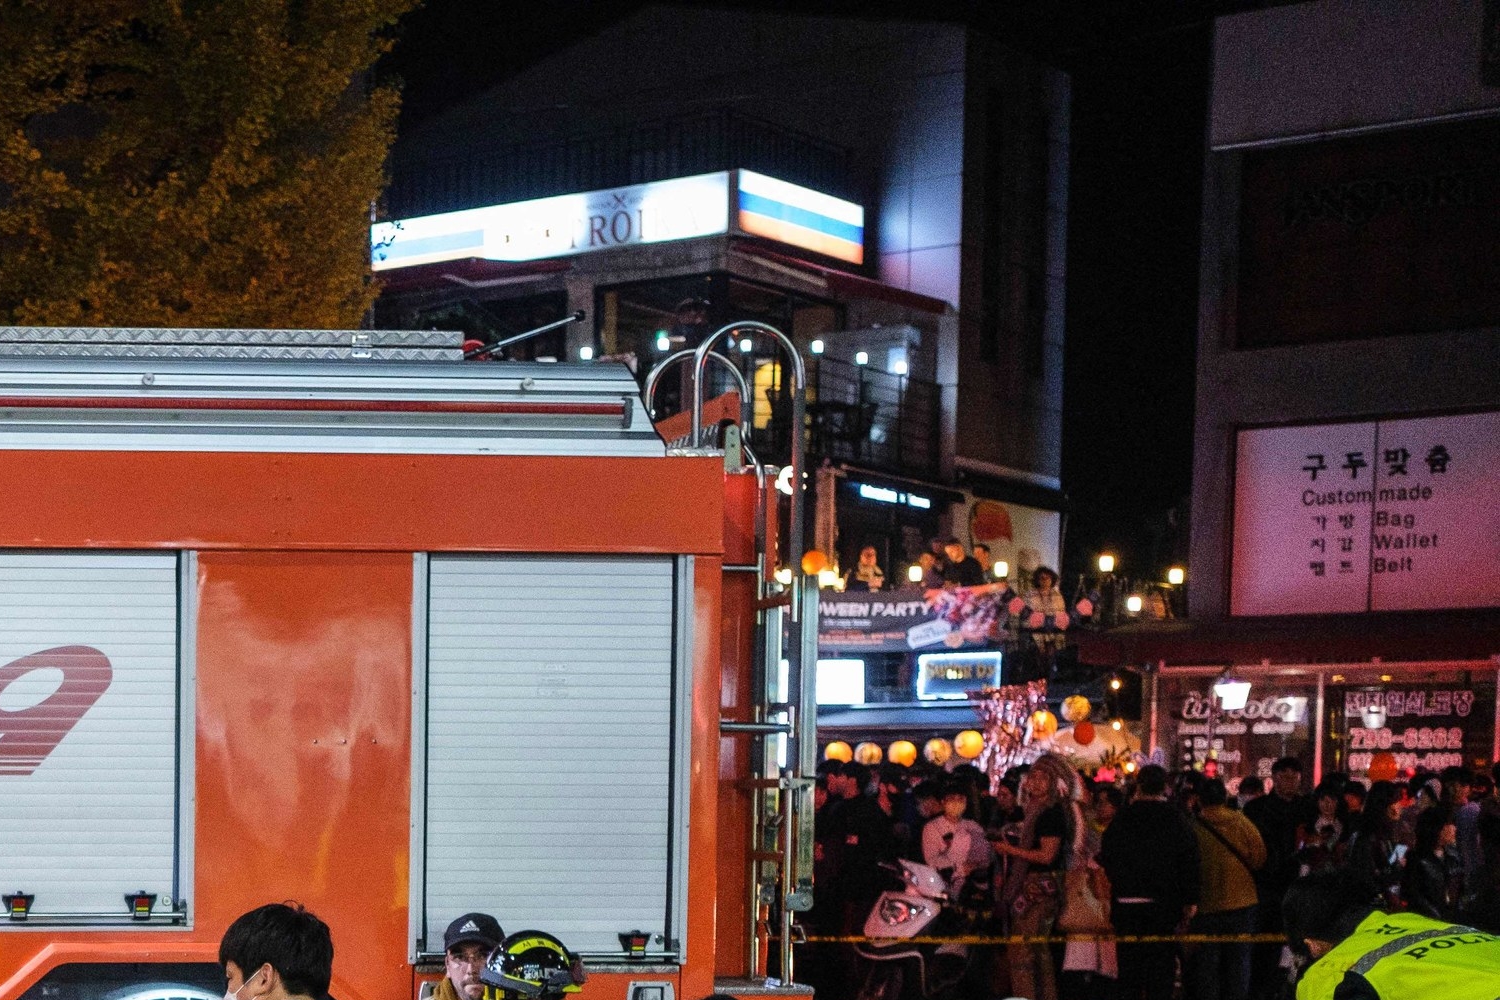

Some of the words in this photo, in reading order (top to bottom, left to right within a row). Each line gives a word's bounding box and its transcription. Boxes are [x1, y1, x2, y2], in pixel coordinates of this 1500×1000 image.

[1302, 488, 1373, 506] Custom
[1379, 483, 1433, 501] made
[1375, 511, 1415, 529] Bag
[1373, 534, 1438, 550] Wallet
[1373, 557, 1413, 574] Belt
[819, 602, 870, 617] WEEN
[871, 601, 933, 617] PARTY
